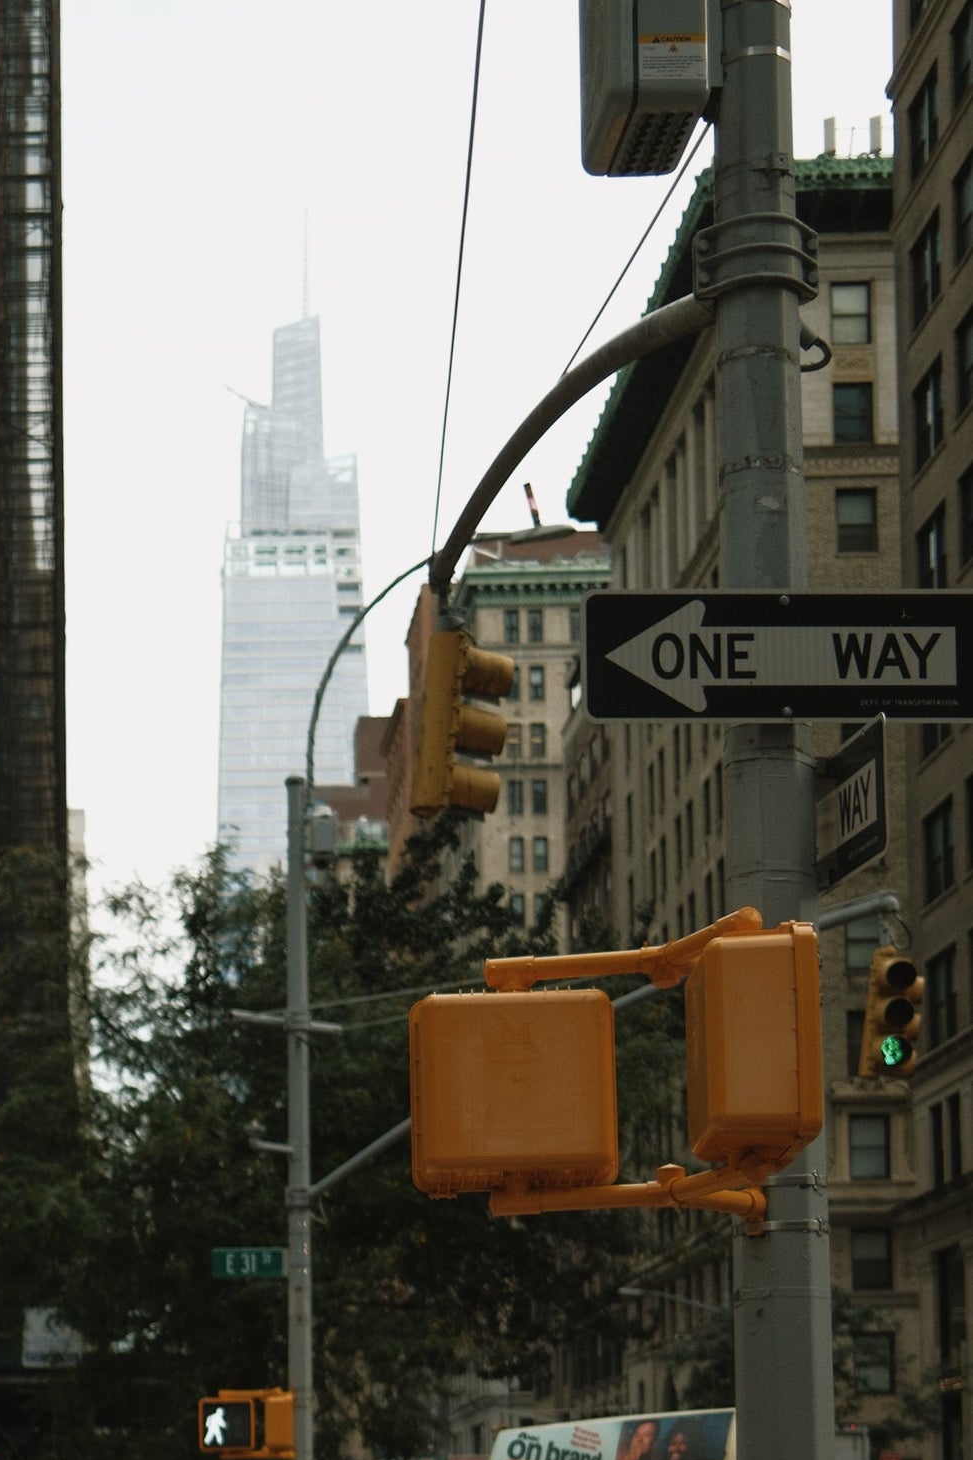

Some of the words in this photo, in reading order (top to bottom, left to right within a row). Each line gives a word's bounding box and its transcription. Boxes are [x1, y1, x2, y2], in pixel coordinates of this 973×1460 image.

[652, 632, 756, 680] ONE
[832, 632, 941, 679] WAY
[838, 769, 871, 837] WAY
[226, 1253, 235, 1275] E
[241, 1253, 257, 1275] 31
